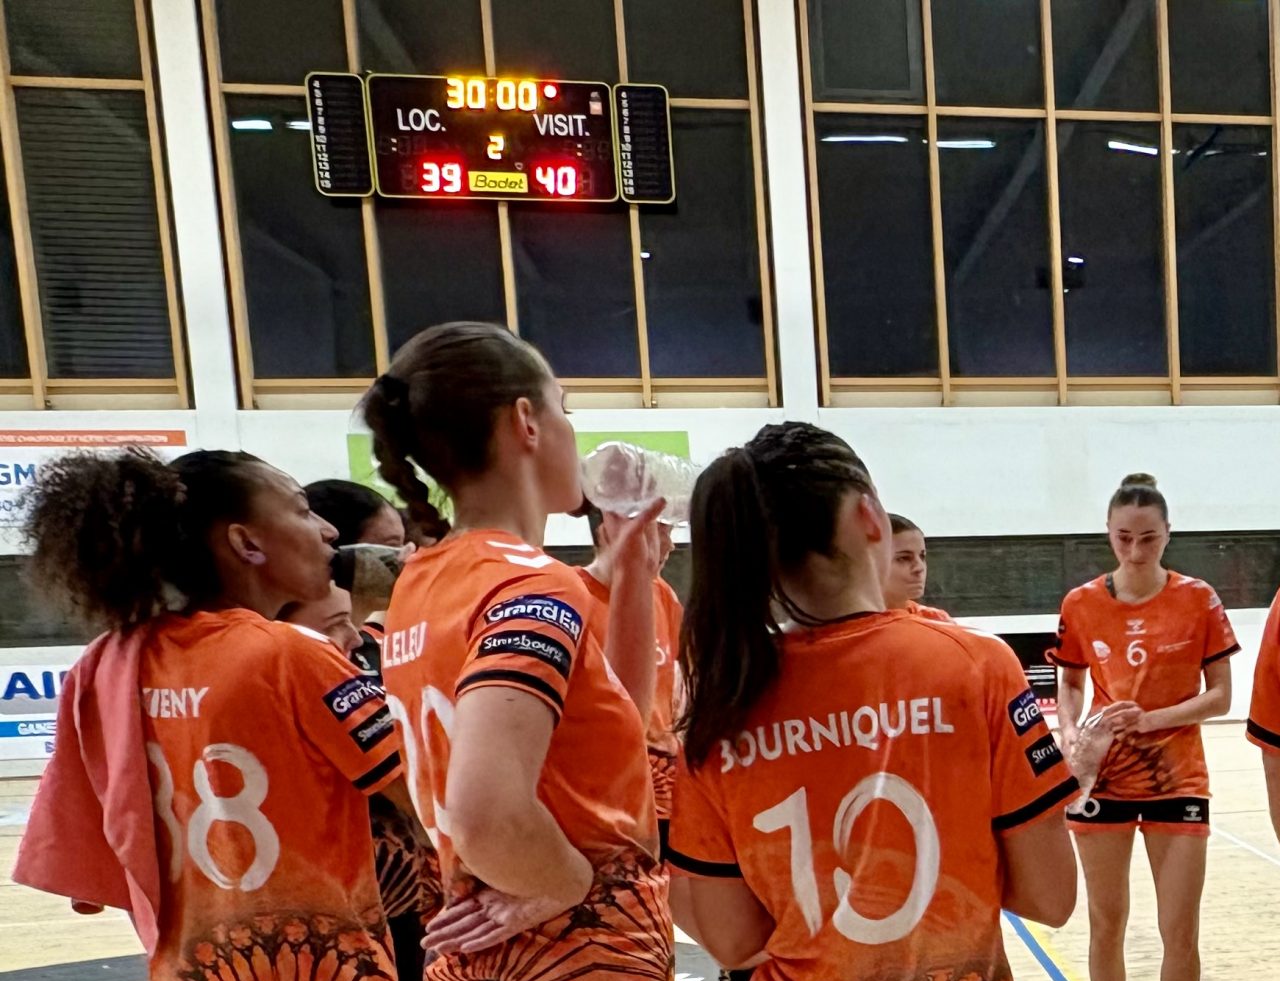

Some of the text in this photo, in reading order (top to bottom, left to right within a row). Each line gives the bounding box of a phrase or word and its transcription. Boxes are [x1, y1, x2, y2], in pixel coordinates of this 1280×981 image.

[446, 77, 538, 111] 30:00
[396, 108, 590, 137] LOC. VISIT.
[487, 135, 504, 160] 2
[422, 162, 461, 192] 39
[474, 175, 524, 189] Bodet
[536, 166, 576, 195] 40
[1126, 639, 1148, 667] 6
[2, 670, 68, 700] AI
[752, 771, 941, 945] 10
